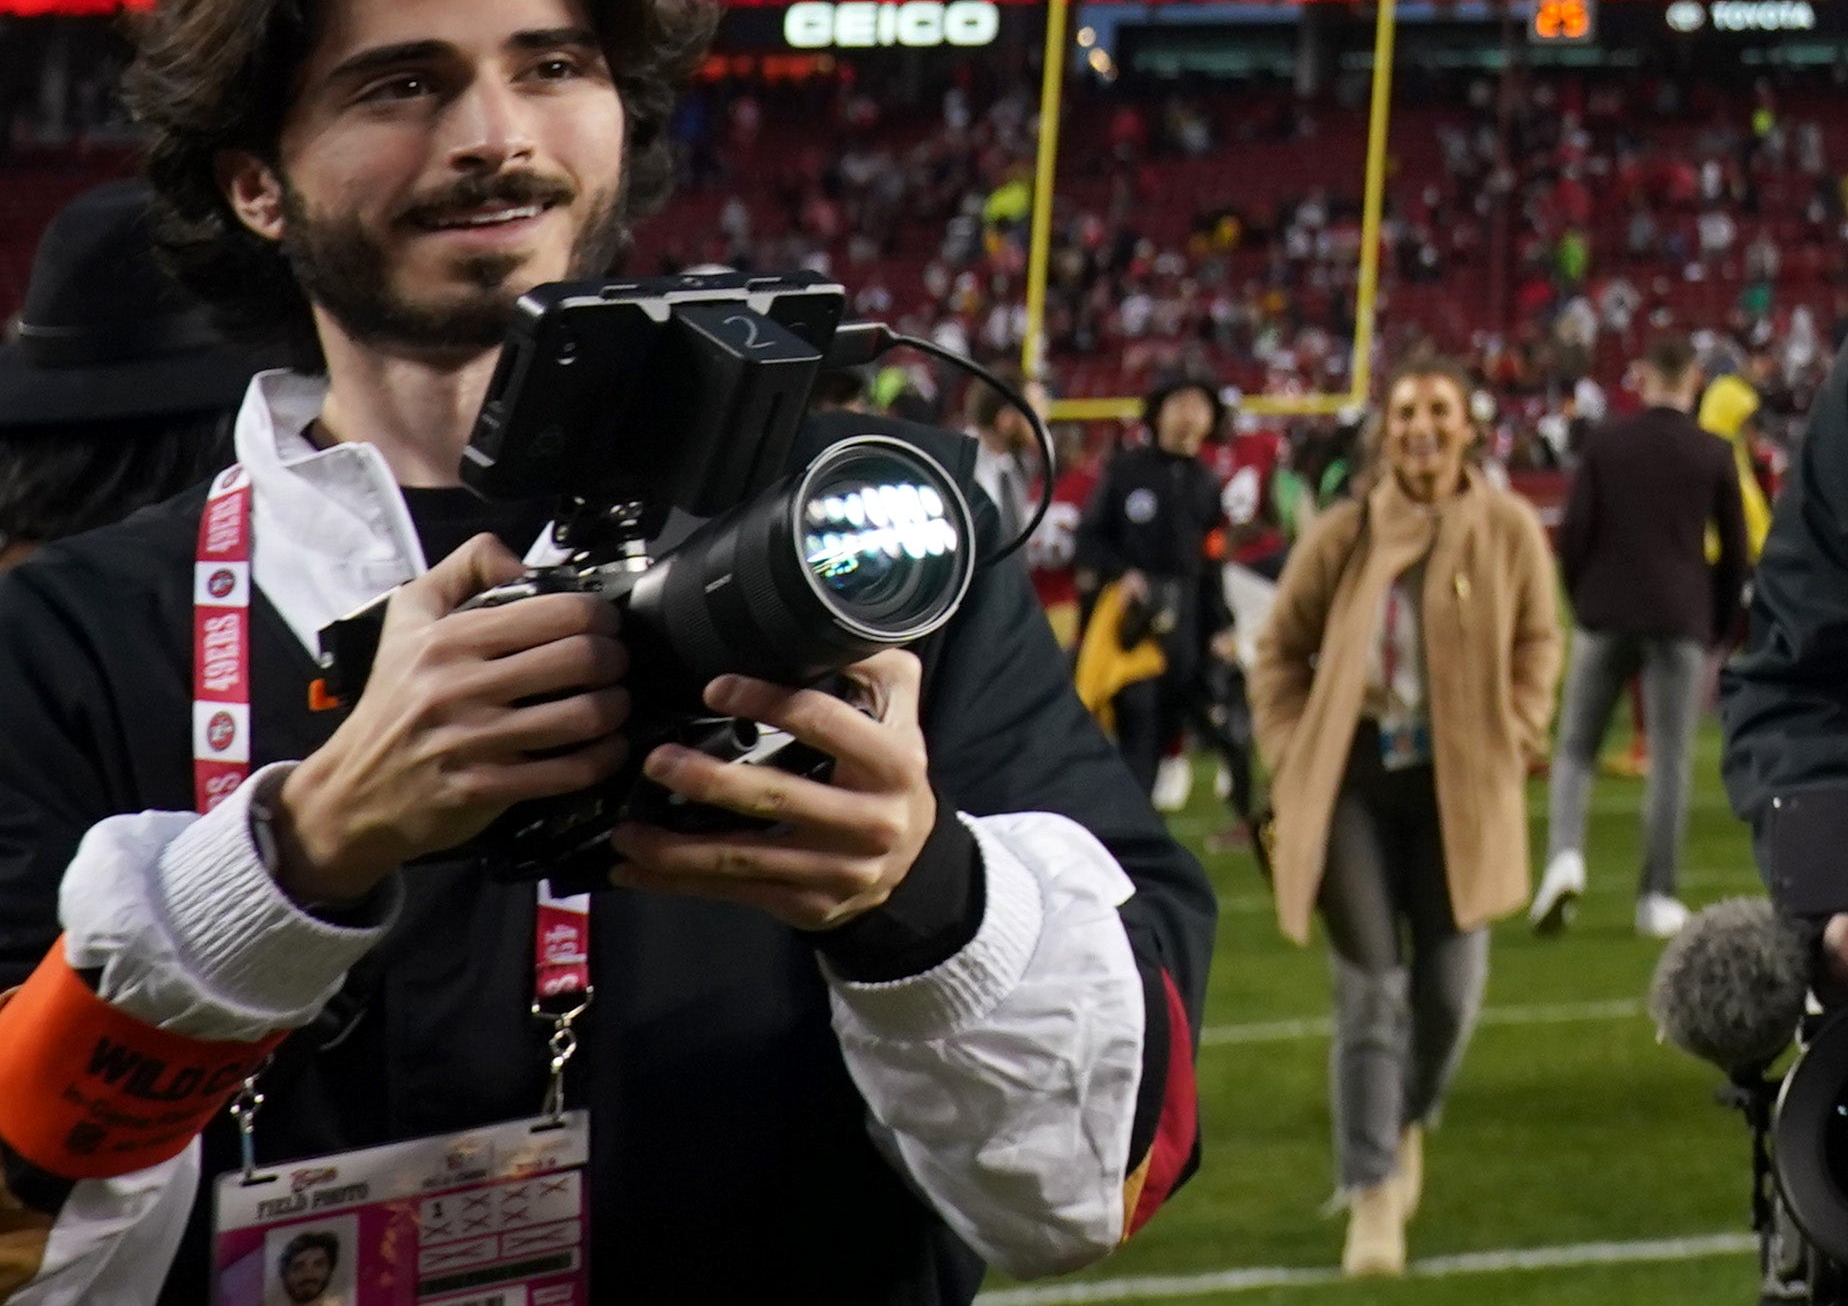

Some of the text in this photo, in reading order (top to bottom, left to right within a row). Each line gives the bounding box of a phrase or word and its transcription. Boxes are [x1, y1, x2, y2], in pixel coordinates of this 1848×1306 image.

[784, 0, 1000, 48] GEICO
[1711, 0, 1816, 32] TOYOTA
[722, 314, 776, 349] 2
[206, 491, 243, 554] 49ERS
[203, 612, 241, 692] 49ERS
